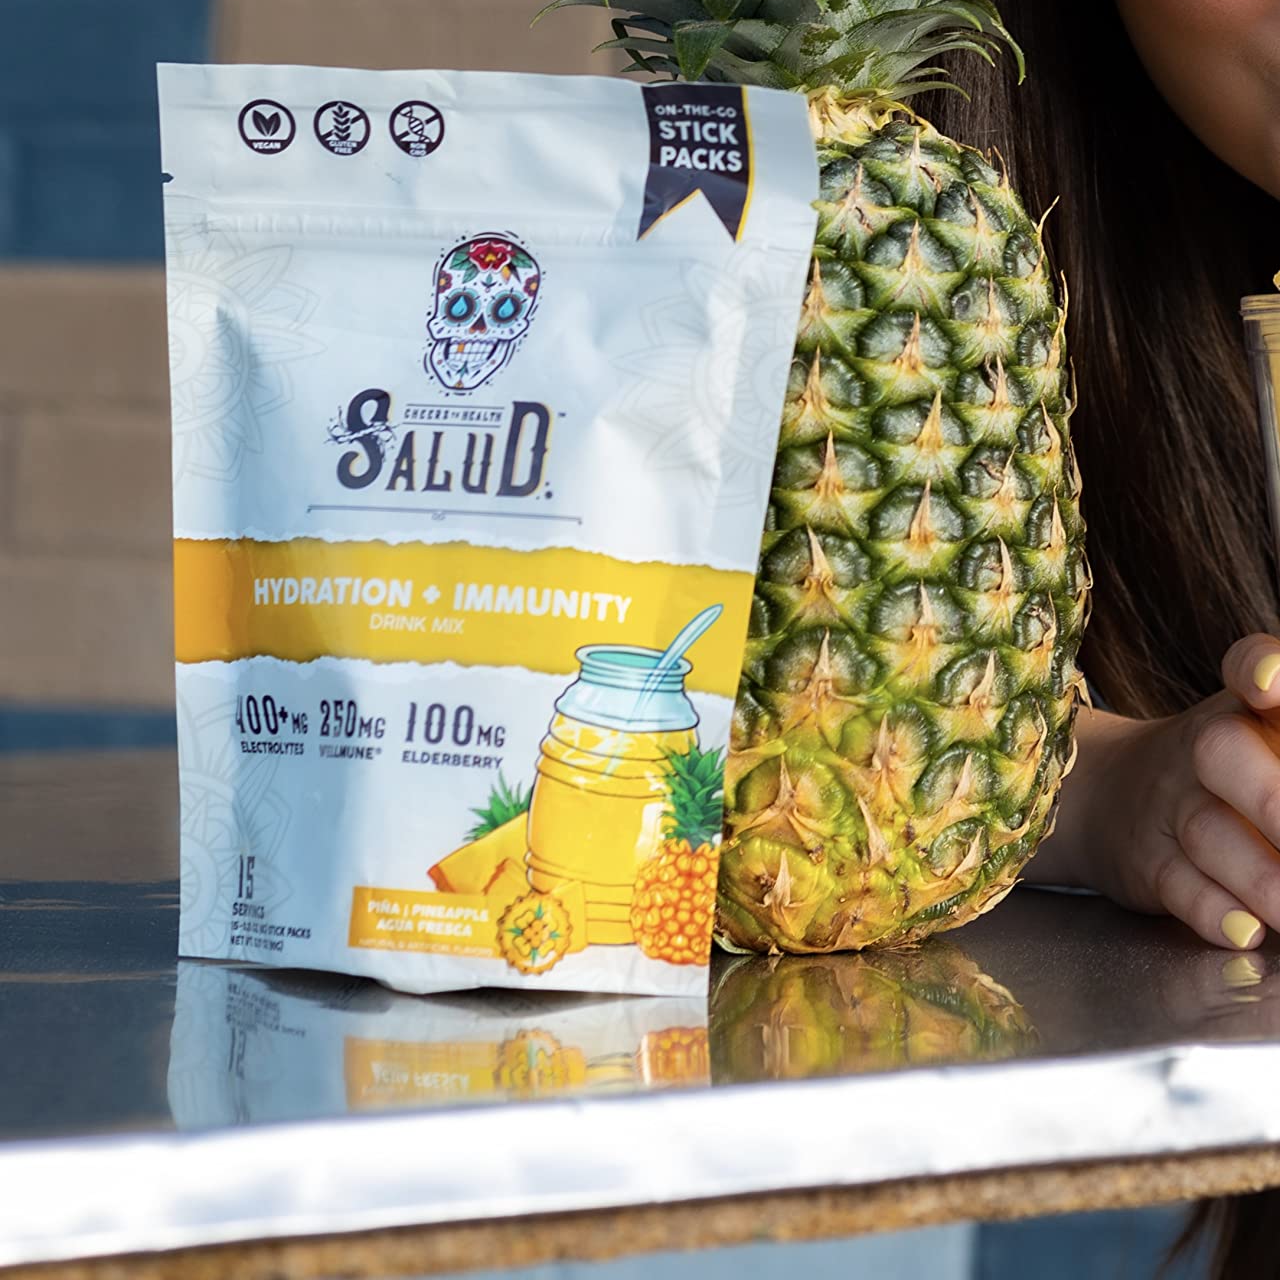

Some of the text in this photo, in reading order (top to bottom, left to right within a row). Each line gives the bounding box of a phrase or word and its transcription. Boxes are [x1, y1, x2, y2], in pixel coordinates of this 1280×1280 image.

[658, 120, 739, 145] STICK
[252, 141, 282, 150] VEGAN
[329, 140, 358, 148] GLUTEN
[660, 146, 743, 172] PACKS
[403, 408, 449, 420] CHEERS
[461, 410, 503, 422] HEALTH
[253, 577, 414, 608] HYDRATION
[453, 583, 632, 623] IMMUNITY
[368, 613, 465, 634] DRINK MIX
[240, 741, 304, 756] ELECTROLYTES
[402, 750, 503, 769] ELDERBERRY
[238, 854, 255, 899] 15
[367, 899, 399, 915] PIÑA
[411, 903, 489, 922] PINEAPPLE
[287, 927, 311, 939] PACKS
[376, 918, 472, 937] AGUA FRESCA
